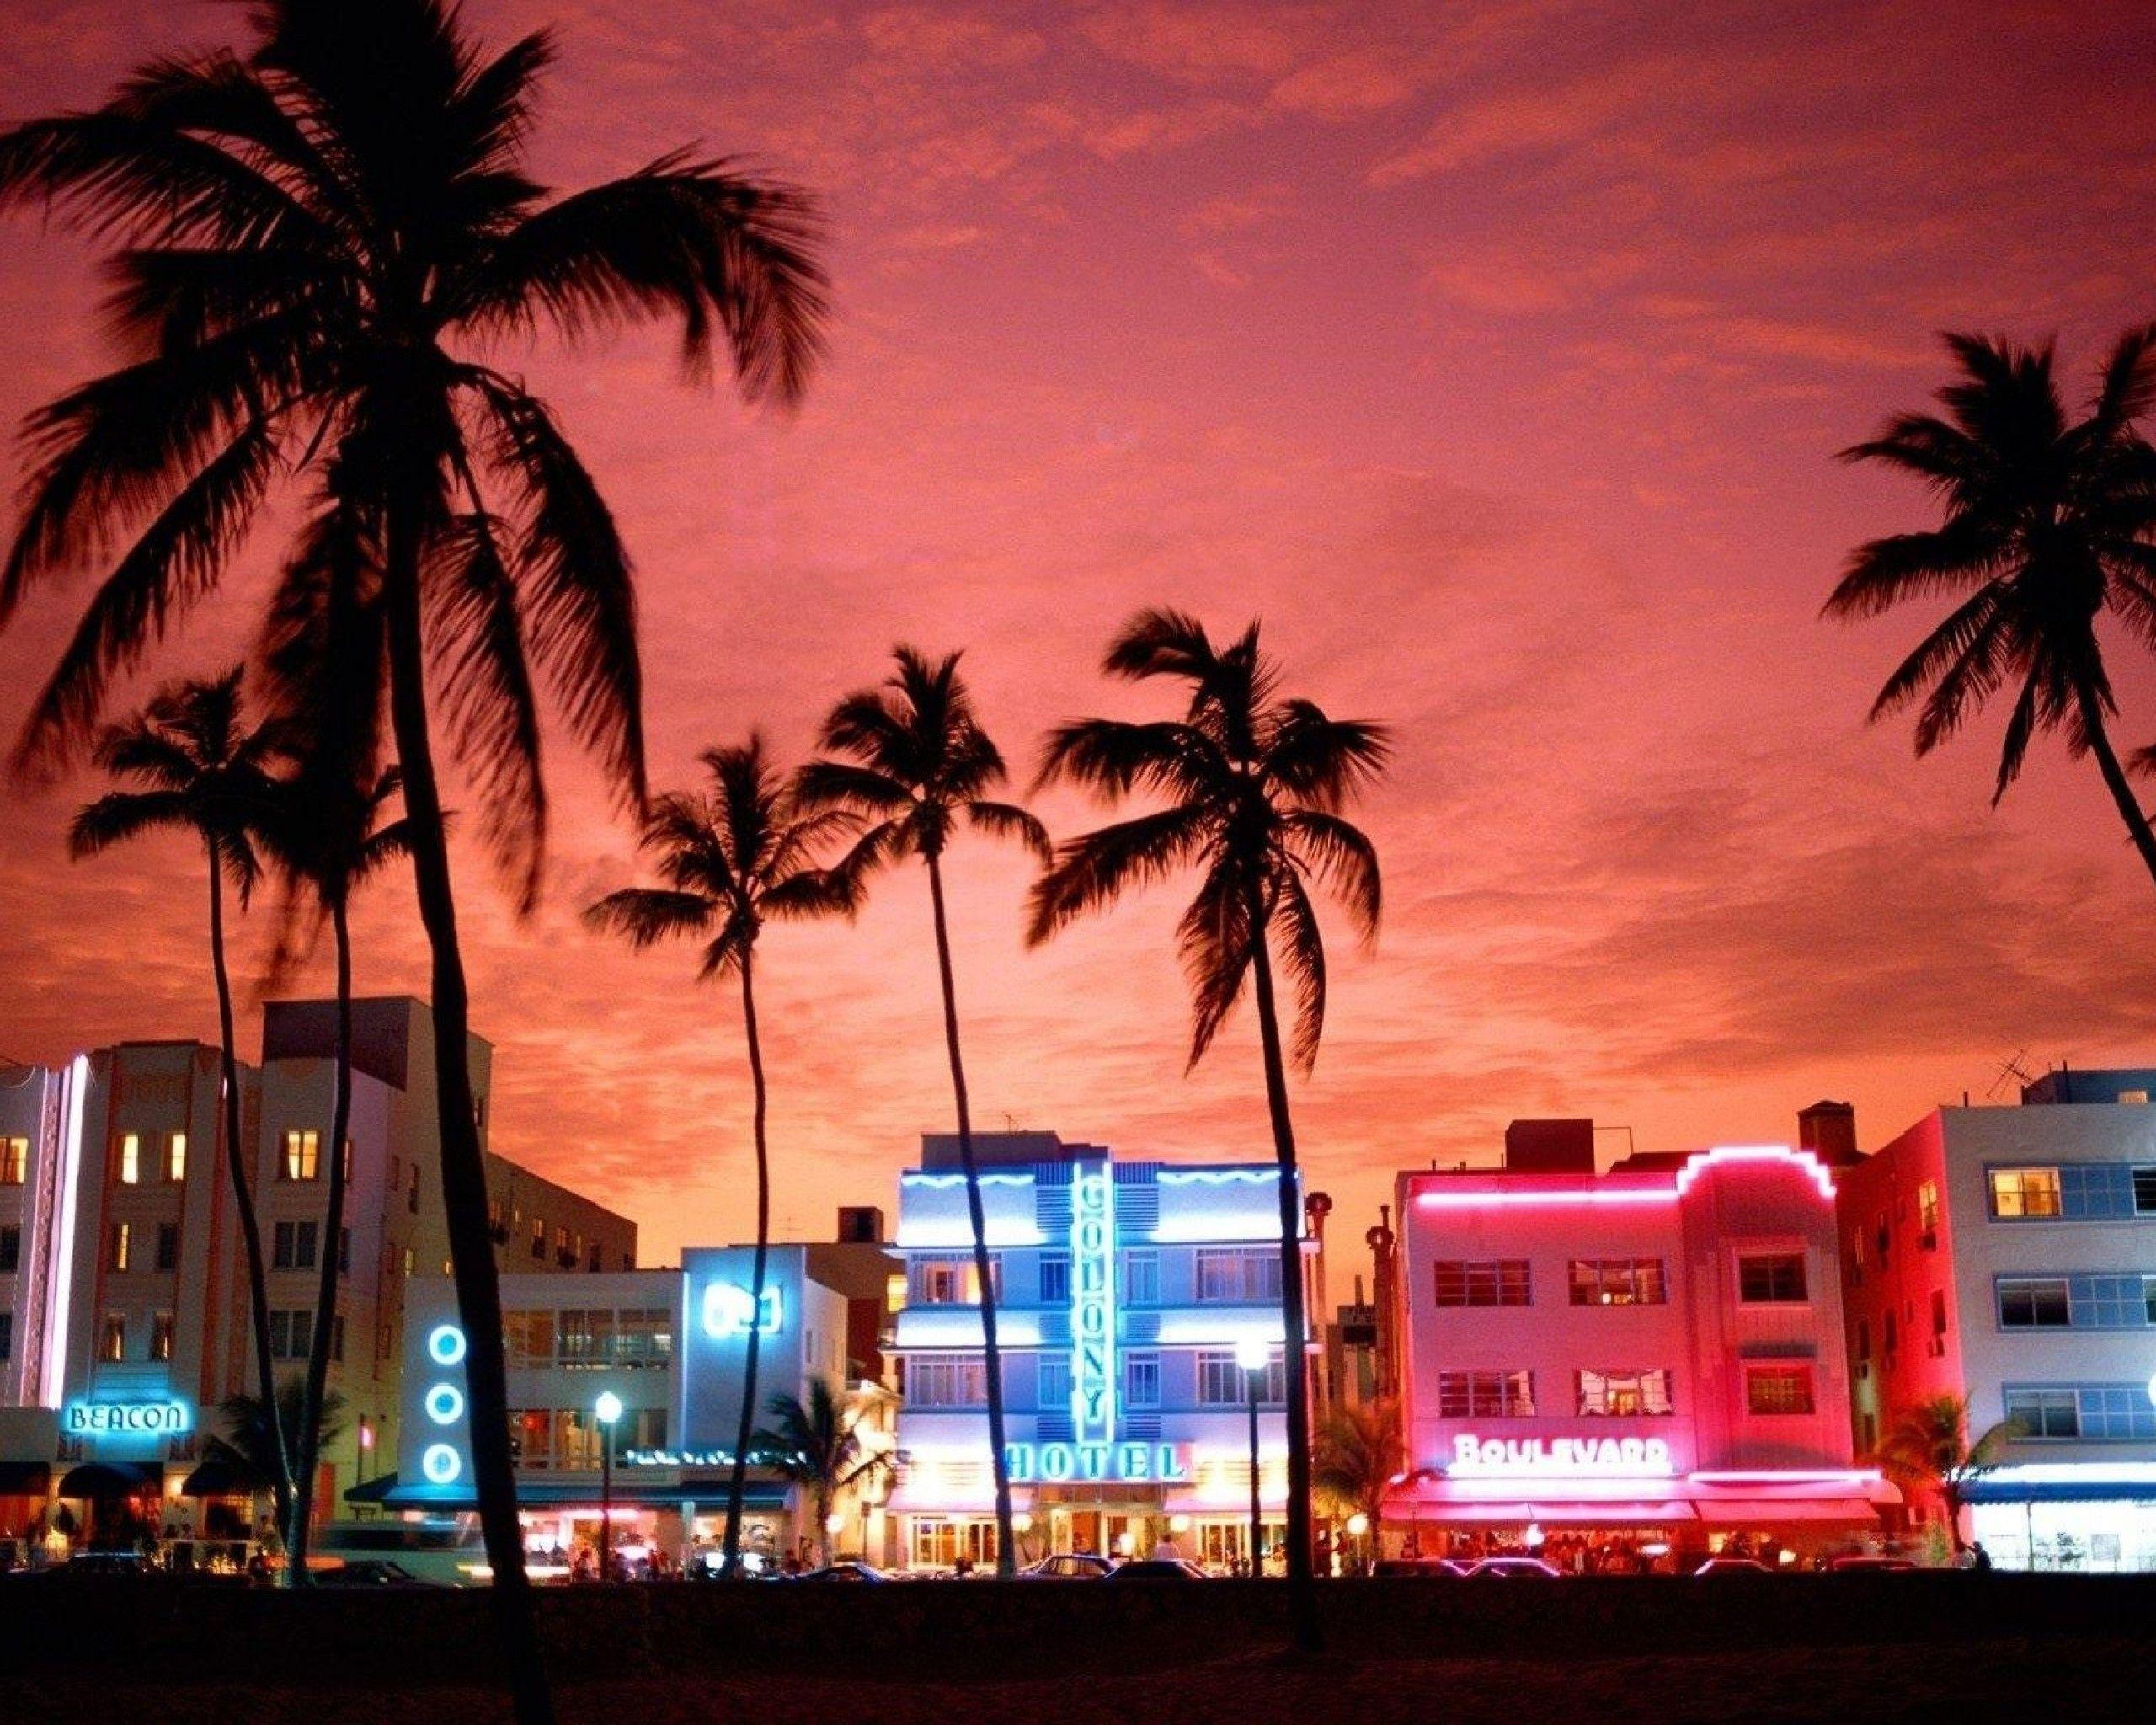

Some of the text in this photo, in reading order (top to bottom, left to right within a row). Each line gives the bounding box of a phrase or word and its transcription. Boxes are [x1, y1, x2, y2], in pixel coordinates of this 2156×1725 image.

[1080, 1179, 1107, 1420] COLONY
[69, 1405, 184, 1430] BEACON
[1003, 1445, 1186, 1478] HOTEL
[1453, 1434, 1671, 1467] BOULEVARD
